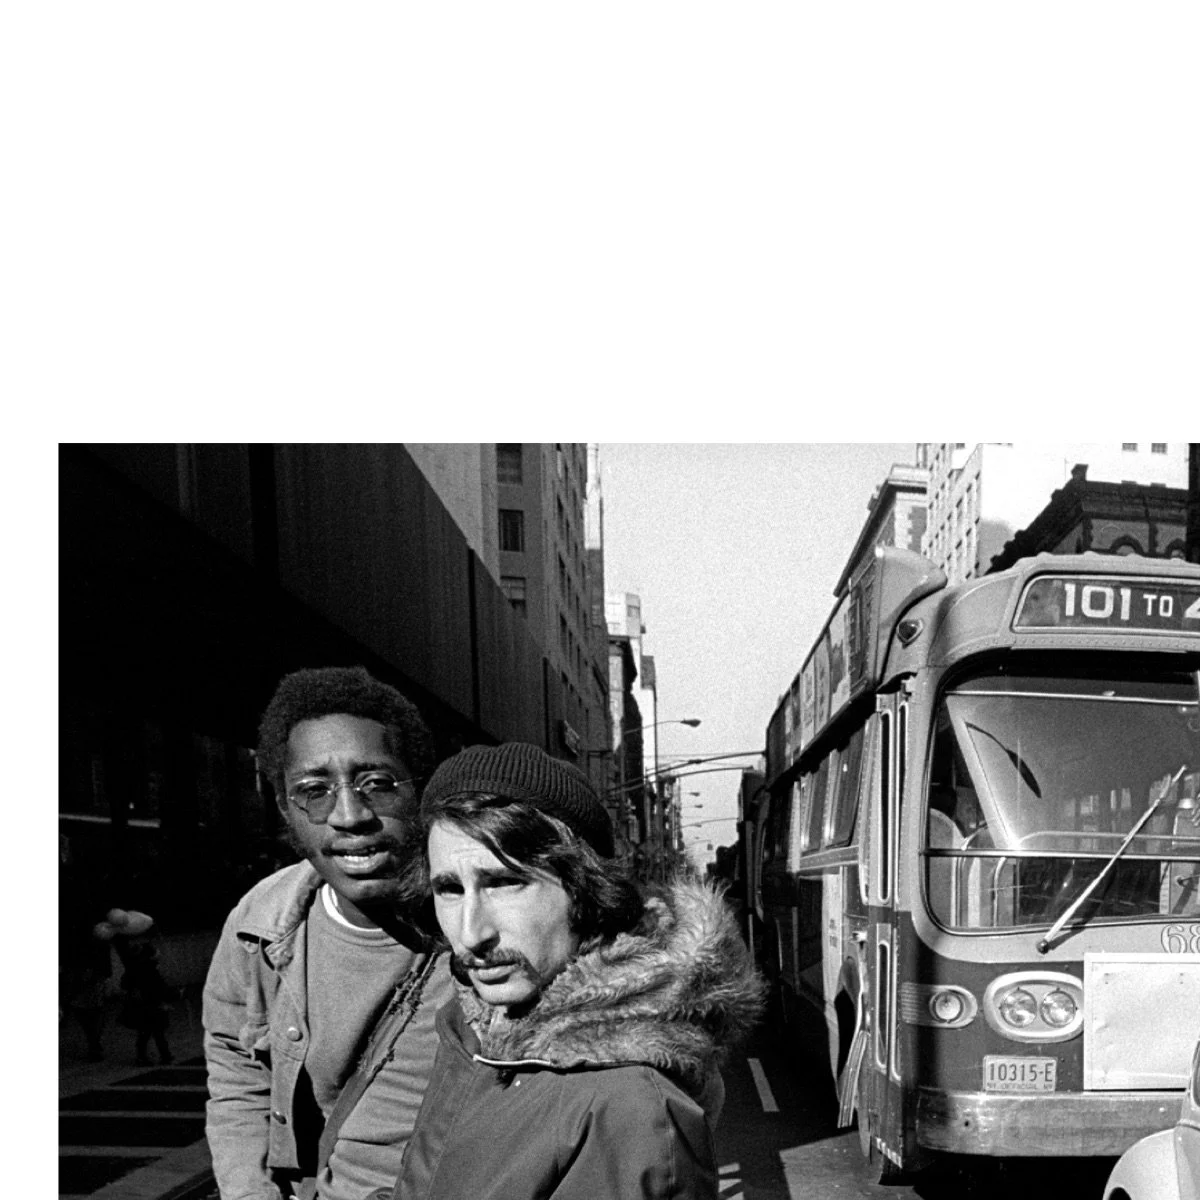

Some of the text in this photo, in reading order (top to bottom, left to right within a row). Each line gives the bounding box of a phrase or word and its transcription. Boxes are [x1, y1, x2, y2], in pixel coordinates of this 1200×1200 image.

[1064, 582, 1132, 621] 101
[1143, 593, 1173, 618] TO
[990, 1062, 1054, 1082] 10315-E
